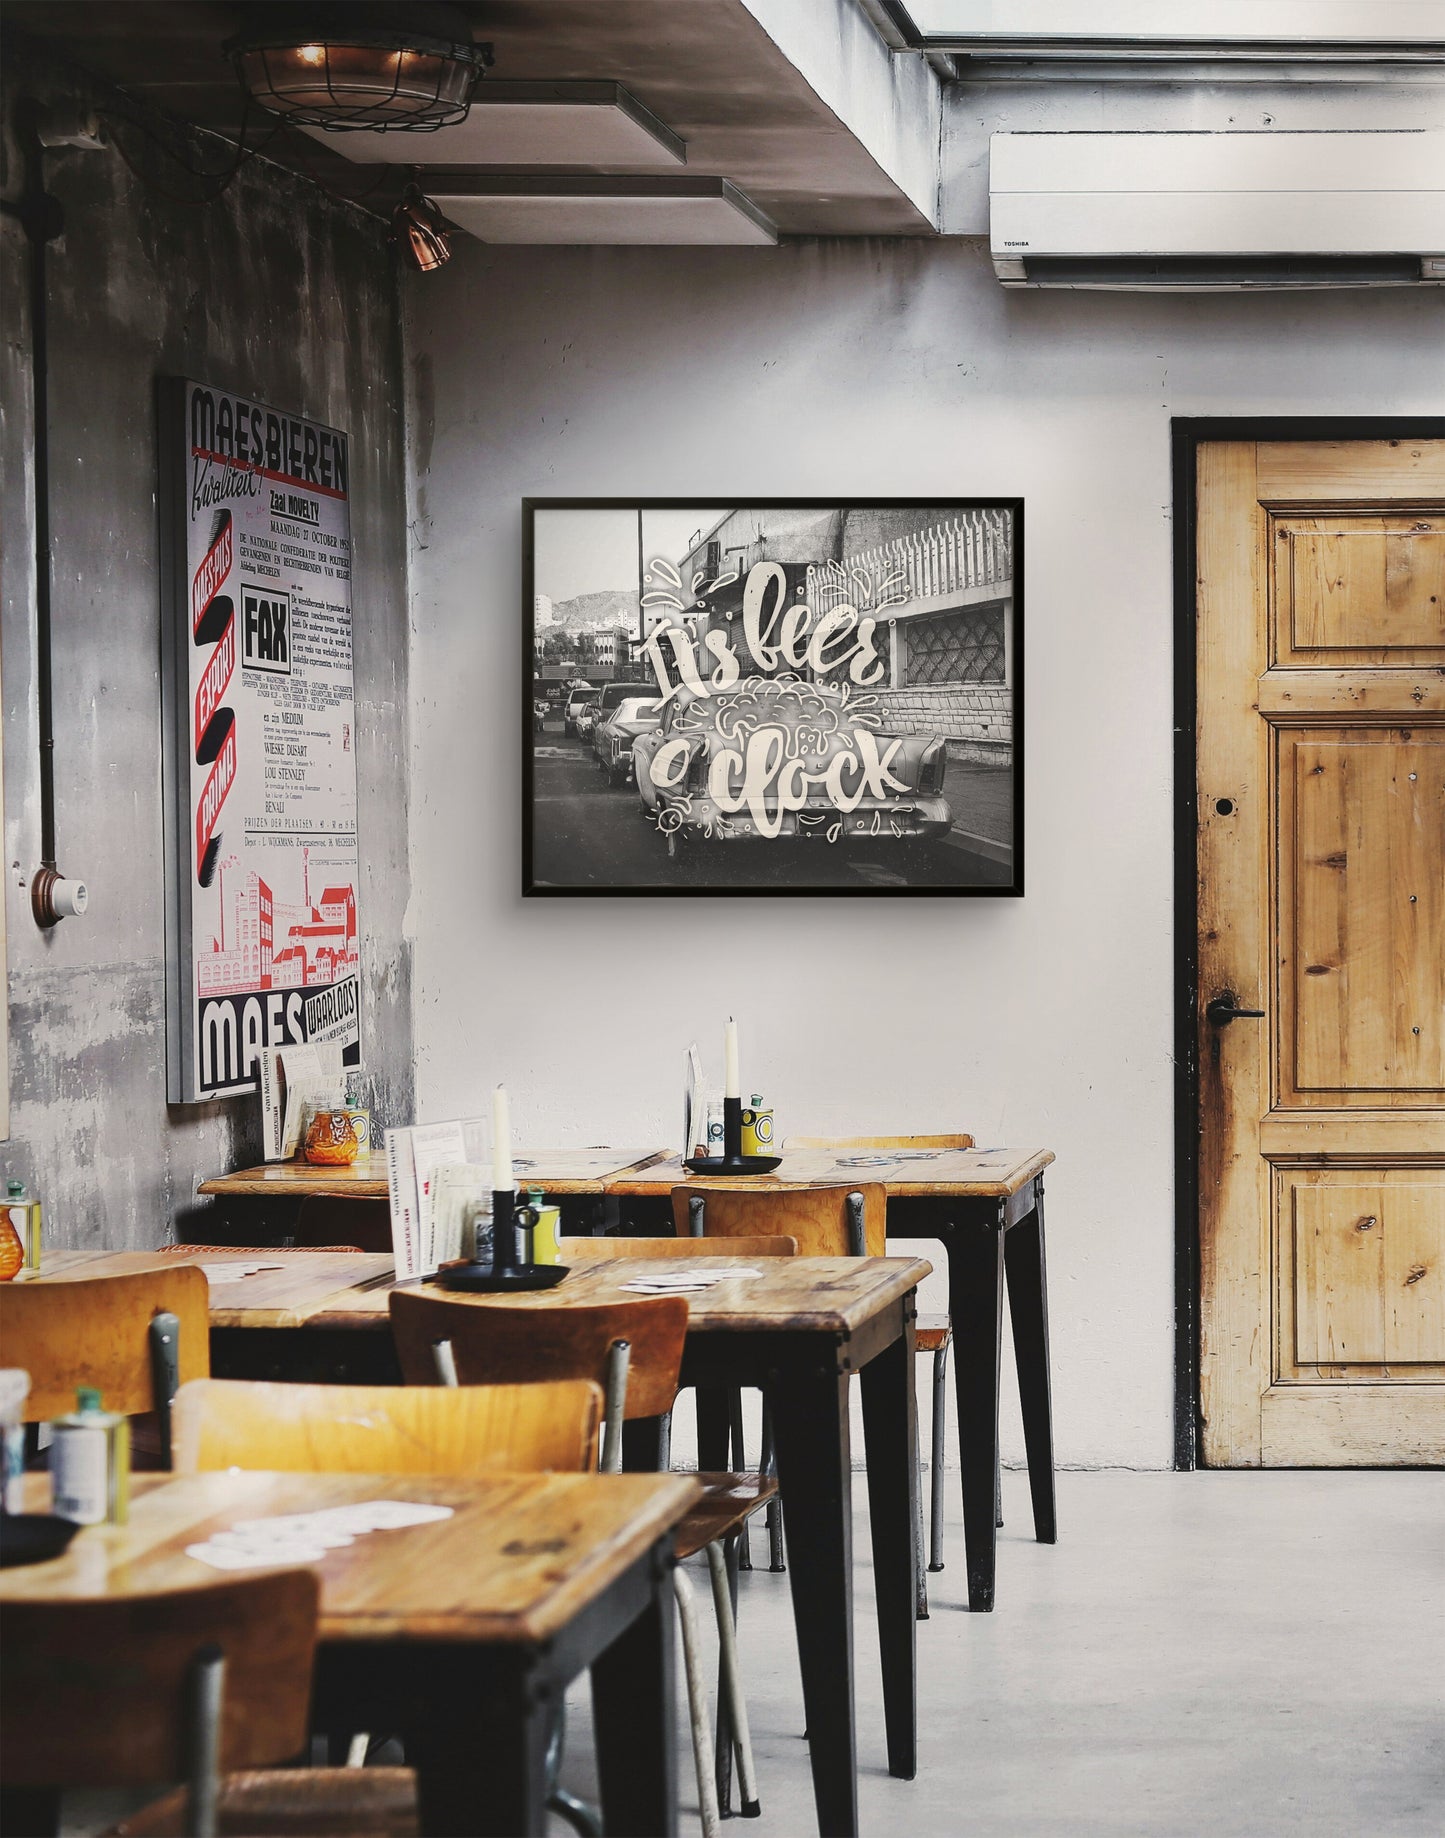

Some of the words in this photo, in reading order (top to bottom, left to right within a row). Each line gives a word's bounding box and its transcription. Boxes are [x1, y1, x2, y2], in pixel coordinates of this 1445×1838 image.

[191, 452, 266, 522] Kwaliteit!
[270, 490, 286, 512] Zaal
[288, 494, 320, 521] NOVELTY
[239, 533, 247, 544] DE
[249, 535, 278, 552] NATIONALE
[280, 543, 317, 561] CONFEDERATIE
[270, 520, 300, 539] MAANDAG
[311, 531, 338, 550] OCTOBER
[194, 528, 231, 624] MAES-PILS
[244, 596, 288, 663] FAX
[743, 561, 885, 686] beer
[200, 620, 234, 732] EXPORT
[281, 711, 304, 726] MEDIUM
[202, 737, 233, 844] PRIMA
[307, 981, 354, 1035] WAARLOOS
